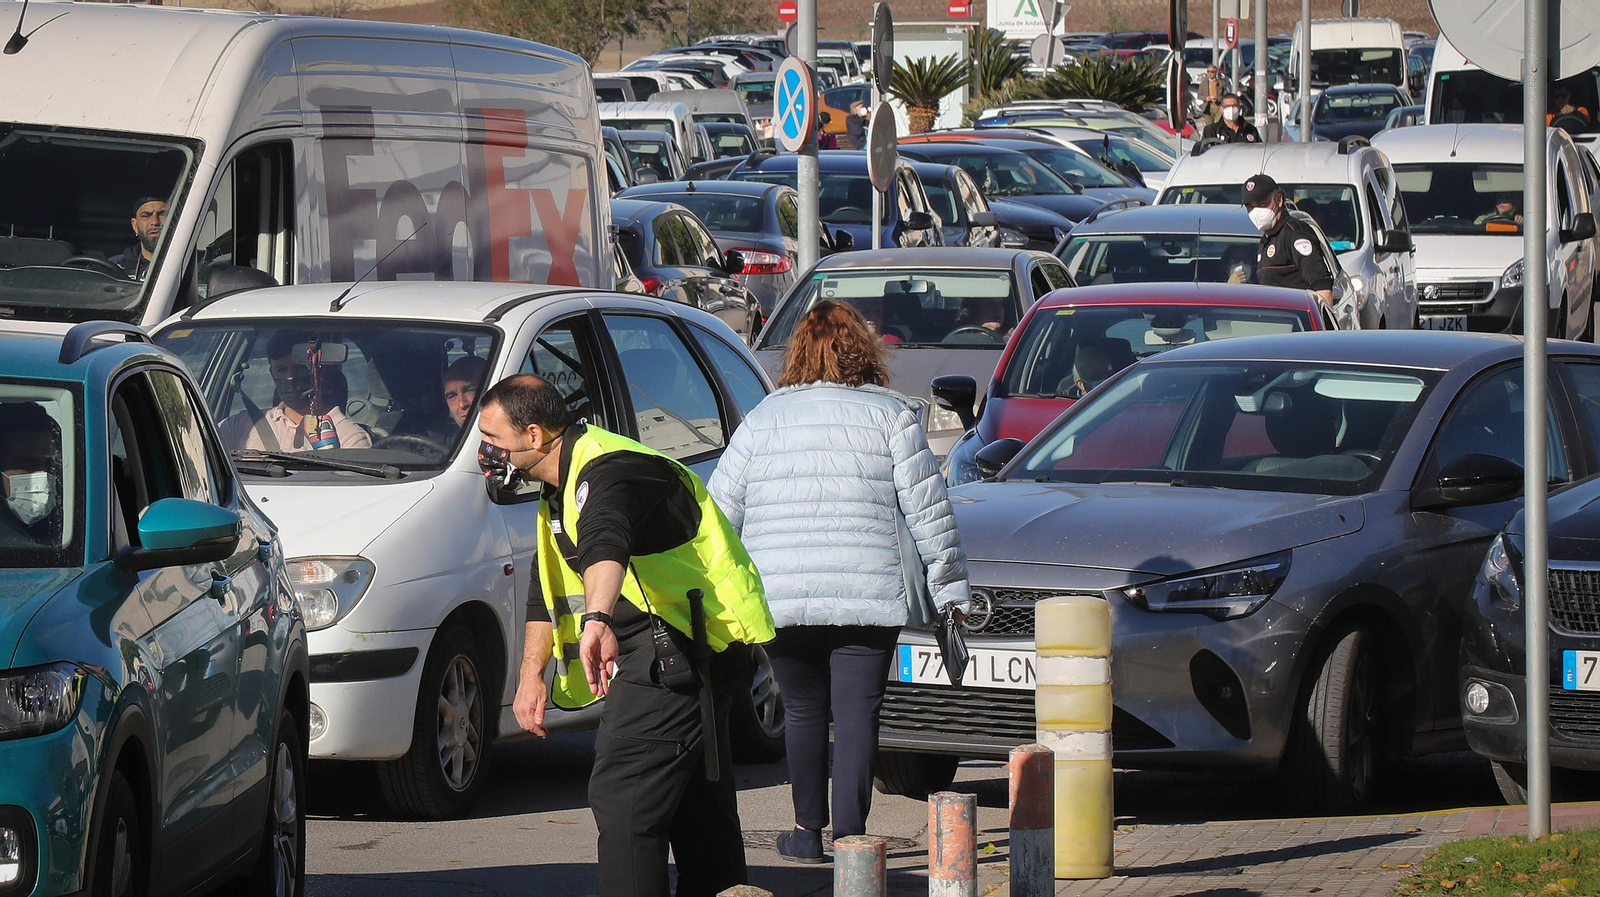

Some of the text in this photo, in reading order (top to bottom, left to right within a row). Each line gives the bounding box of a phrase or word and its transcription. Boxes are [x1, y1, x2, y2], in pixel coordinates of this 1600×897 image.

[319, 104, 587, 288] FedEx
[1439, 317, 1463, 331] JZK
[903, 666, 909, 675] E
[918, 651, 978, 681] 771
